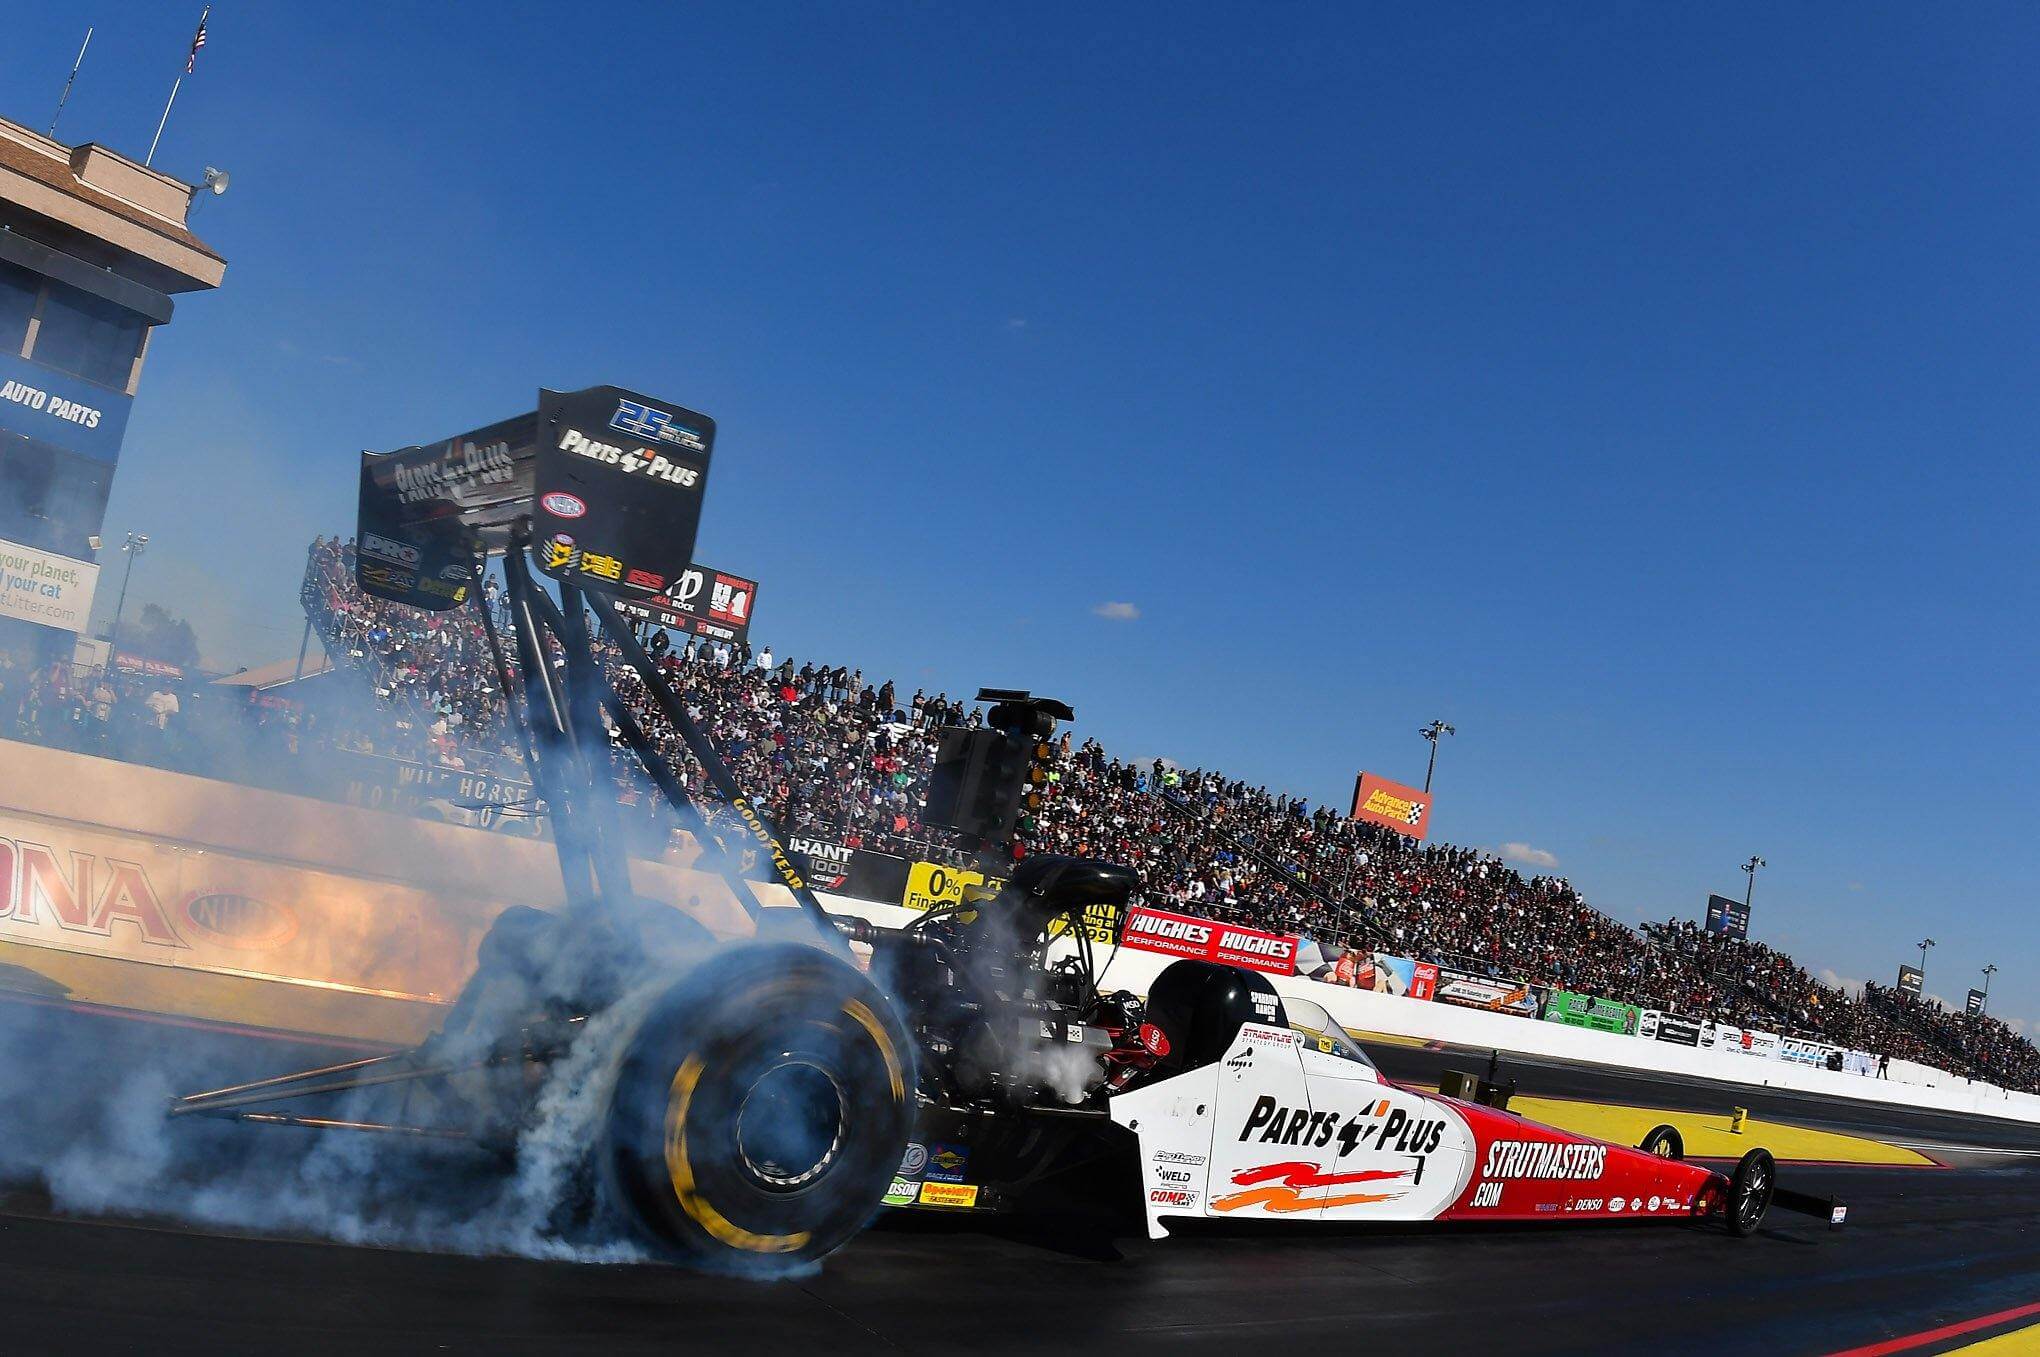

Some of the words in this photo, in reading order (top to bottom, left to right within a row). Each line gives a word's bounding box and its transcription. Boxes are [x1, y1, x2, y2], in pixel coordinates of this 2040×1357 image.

[0, 380, 47, 410] AUTO
[47, 396, 101, 428] PARTS
[559, 429, 624, 465] PARTS
[646, 455, 699, 488] PLUS
[40, 583, 62, 600] cat
[672, 600, 695, 612] ROCK
[1362, 799, 1384, 814] Auto
[1368, 788, 1410, 812] Advance
[733, 798, 804, 890] GOODYEAR
[929, 869, 960, 897] 0%
[1131, 913, 1212, 944] HUGHES
[1219, 931, 1293, 958] HUGHES
[1126, 935, 1208, 956] PERFORMANCE
[1217, 952, 1289, 970] PERFORMANCE
[1122, 1000, 1140, 1010] MSD
[1147, 1029, 1160, 1051] MSD
[1238, 1095, 1340, 1148] PARTS
[1375, 1108, 1446, 1154] PLUS
[1482, 1140, 1607, 1179] STRUTMASTERS
[1162, 1170, 1191, 1182] WELD
[888, 1182, 919, 1196] DSON
[1150, 1190, 1187, 1203] COMP
[1469, 1182, 1504, 1207] .COM
[1575, 1198, 1603, 1211] DENSO
